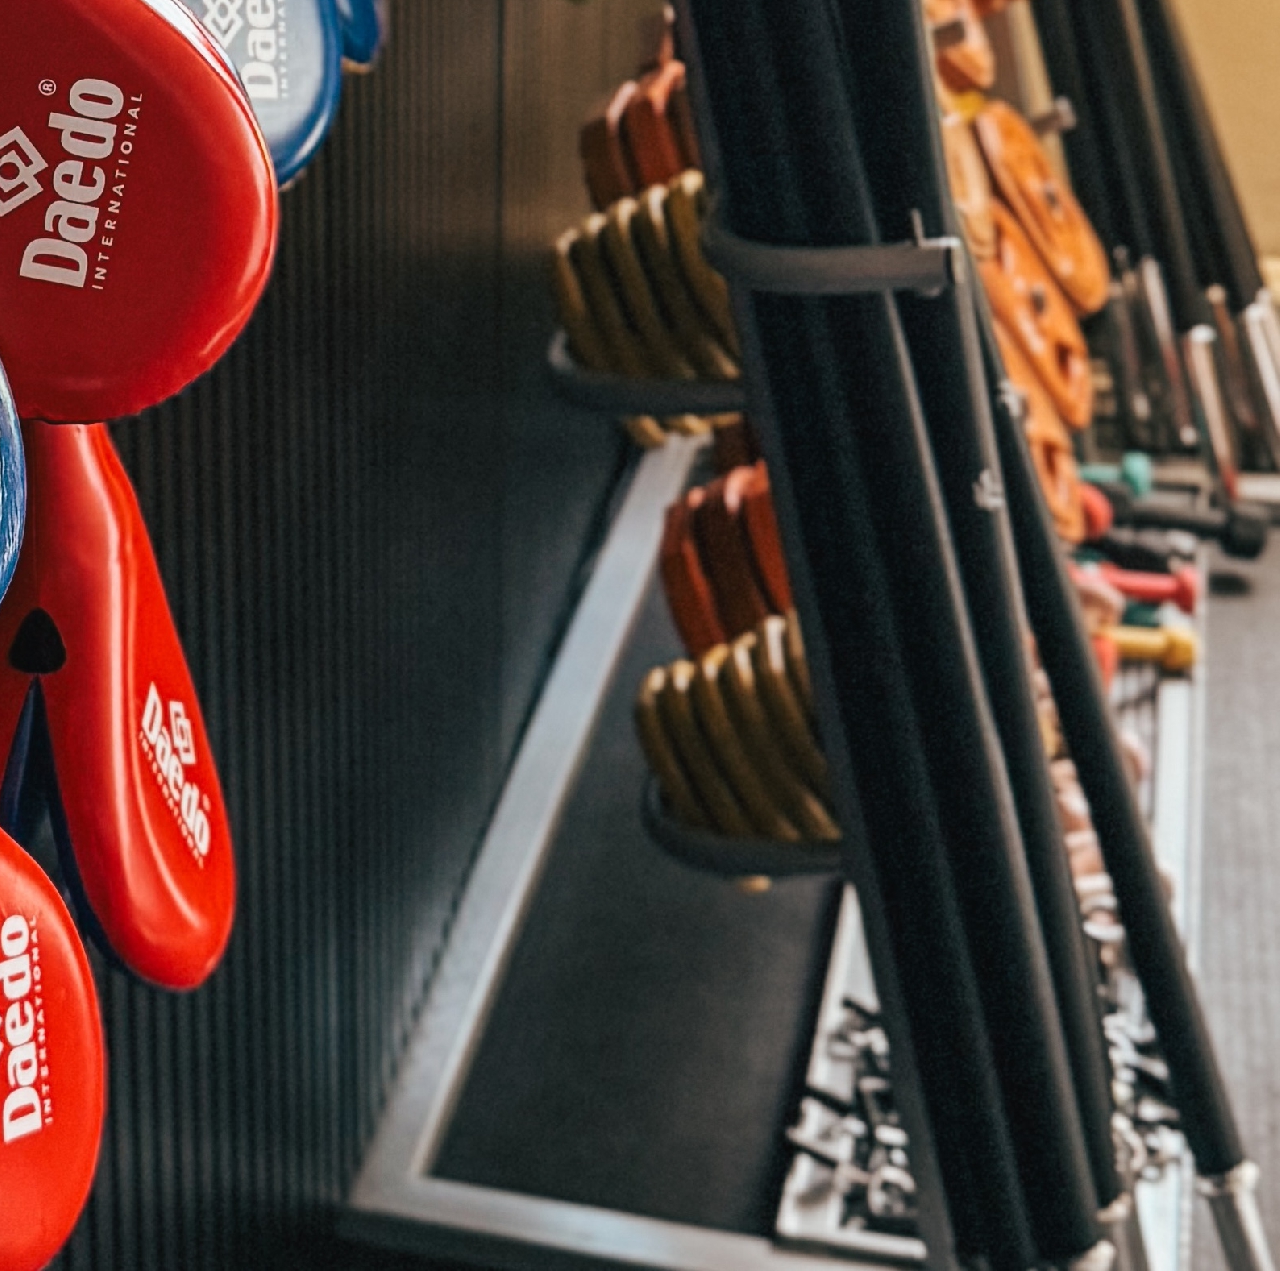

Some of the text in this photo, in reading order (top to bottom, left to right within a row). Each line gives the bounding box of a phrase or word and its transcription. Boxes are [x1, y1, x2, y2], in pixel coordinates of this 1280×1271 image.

[20, 78, 124, 288] Daedo
[92, 93, 143, 290] INTERNATIONAL
[141, 681, 211, 856] Daedo
